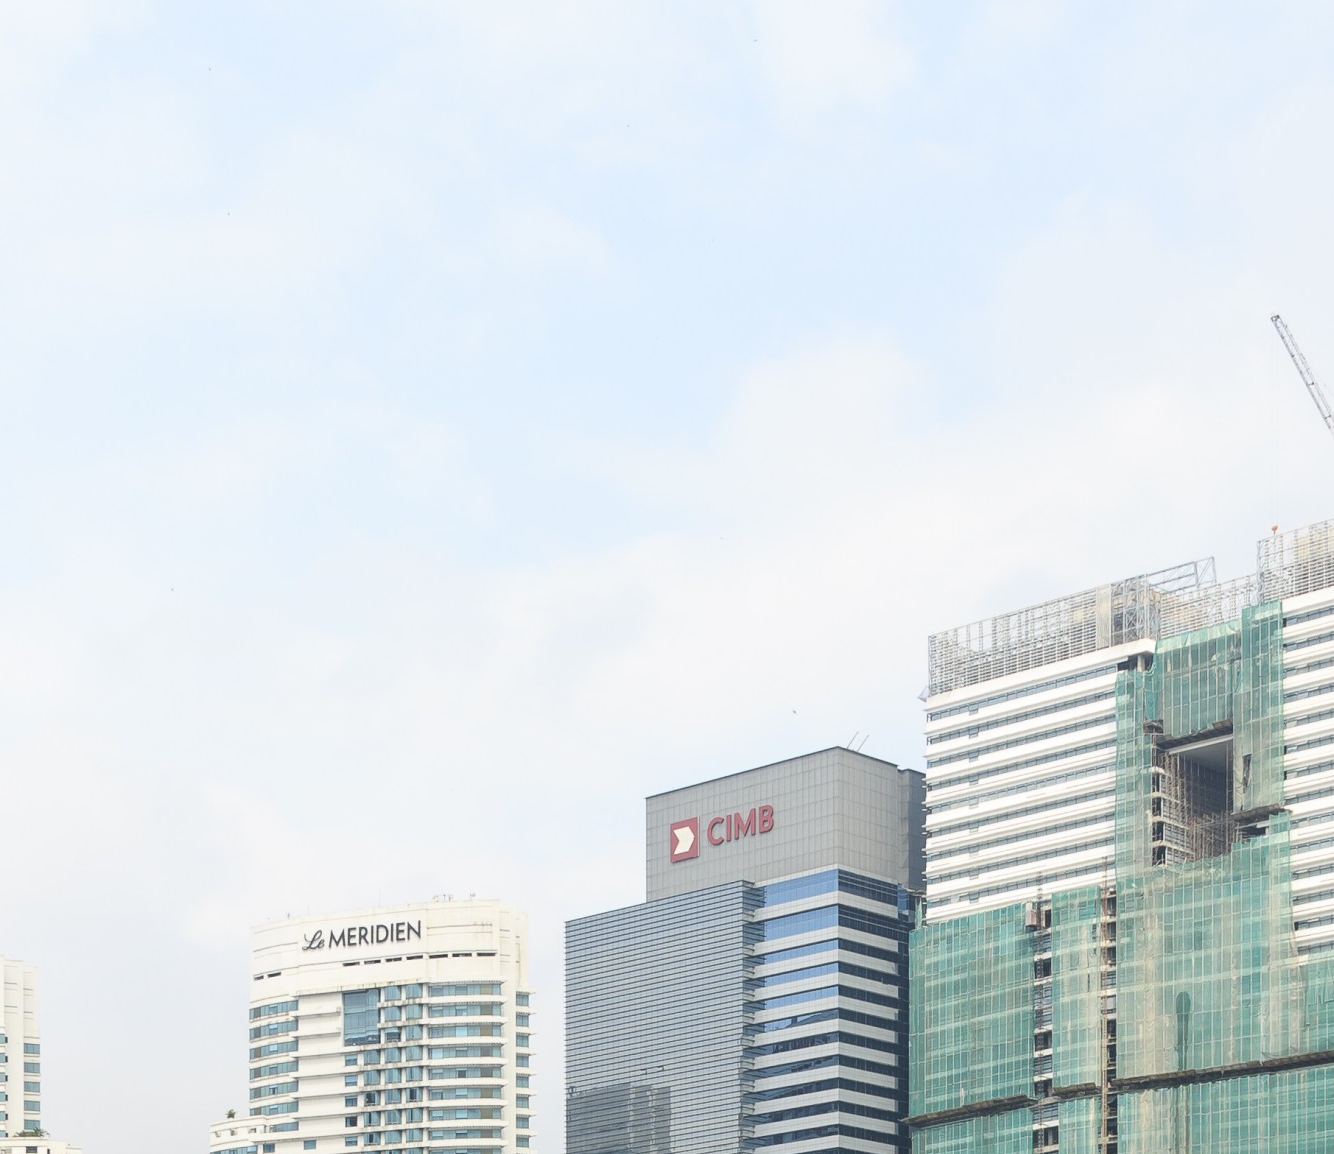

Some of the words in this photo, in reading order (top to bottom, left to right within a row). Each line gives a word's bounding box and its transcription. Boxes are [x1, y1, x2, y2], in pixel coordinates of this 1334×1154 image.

[707, 804, 774, 846] CIMB
[302, 929, 325, 950] Le
[328, 919, 422, 949] MERIDIEN
